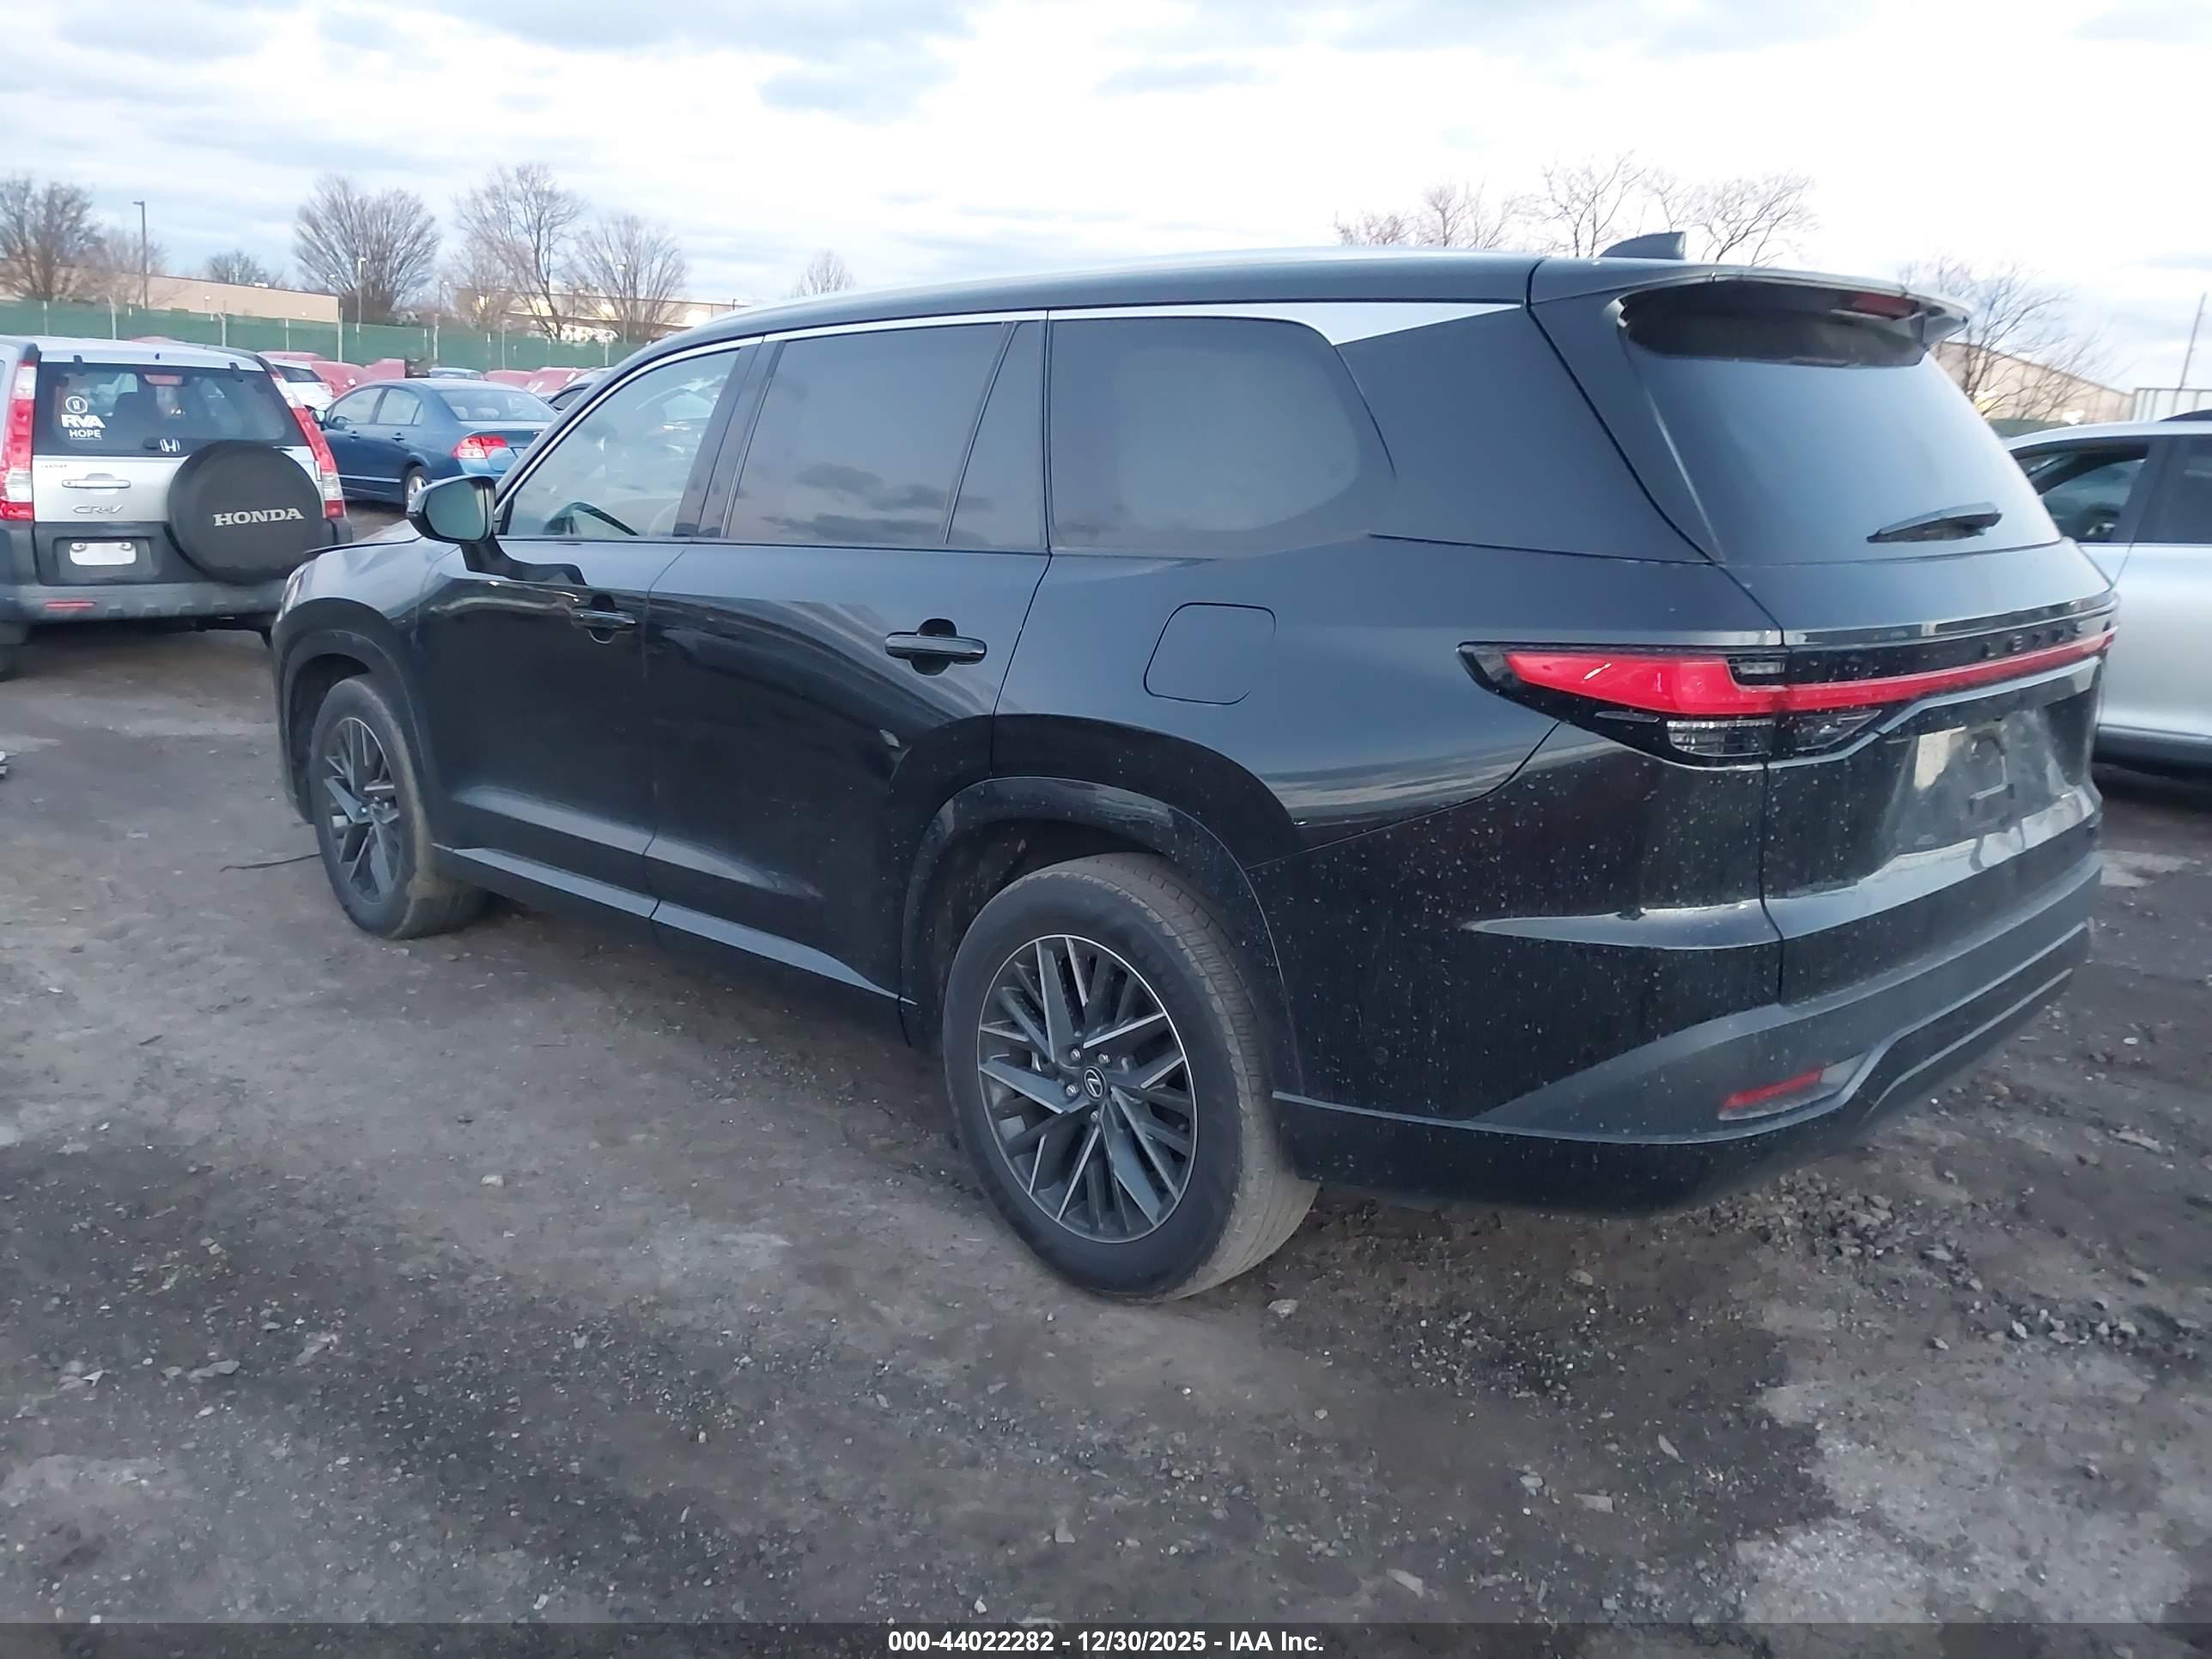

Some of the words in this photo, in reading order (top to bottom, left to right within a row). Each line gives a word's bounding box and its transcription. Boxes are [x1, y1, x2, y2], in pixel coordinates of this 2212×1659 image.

[61, 414, 106, 428] RVA
[69, 429, 102, 438] HOPE
[73, 505, 124, 514] CR-V
[212, 507, 305, 527] HONDA
